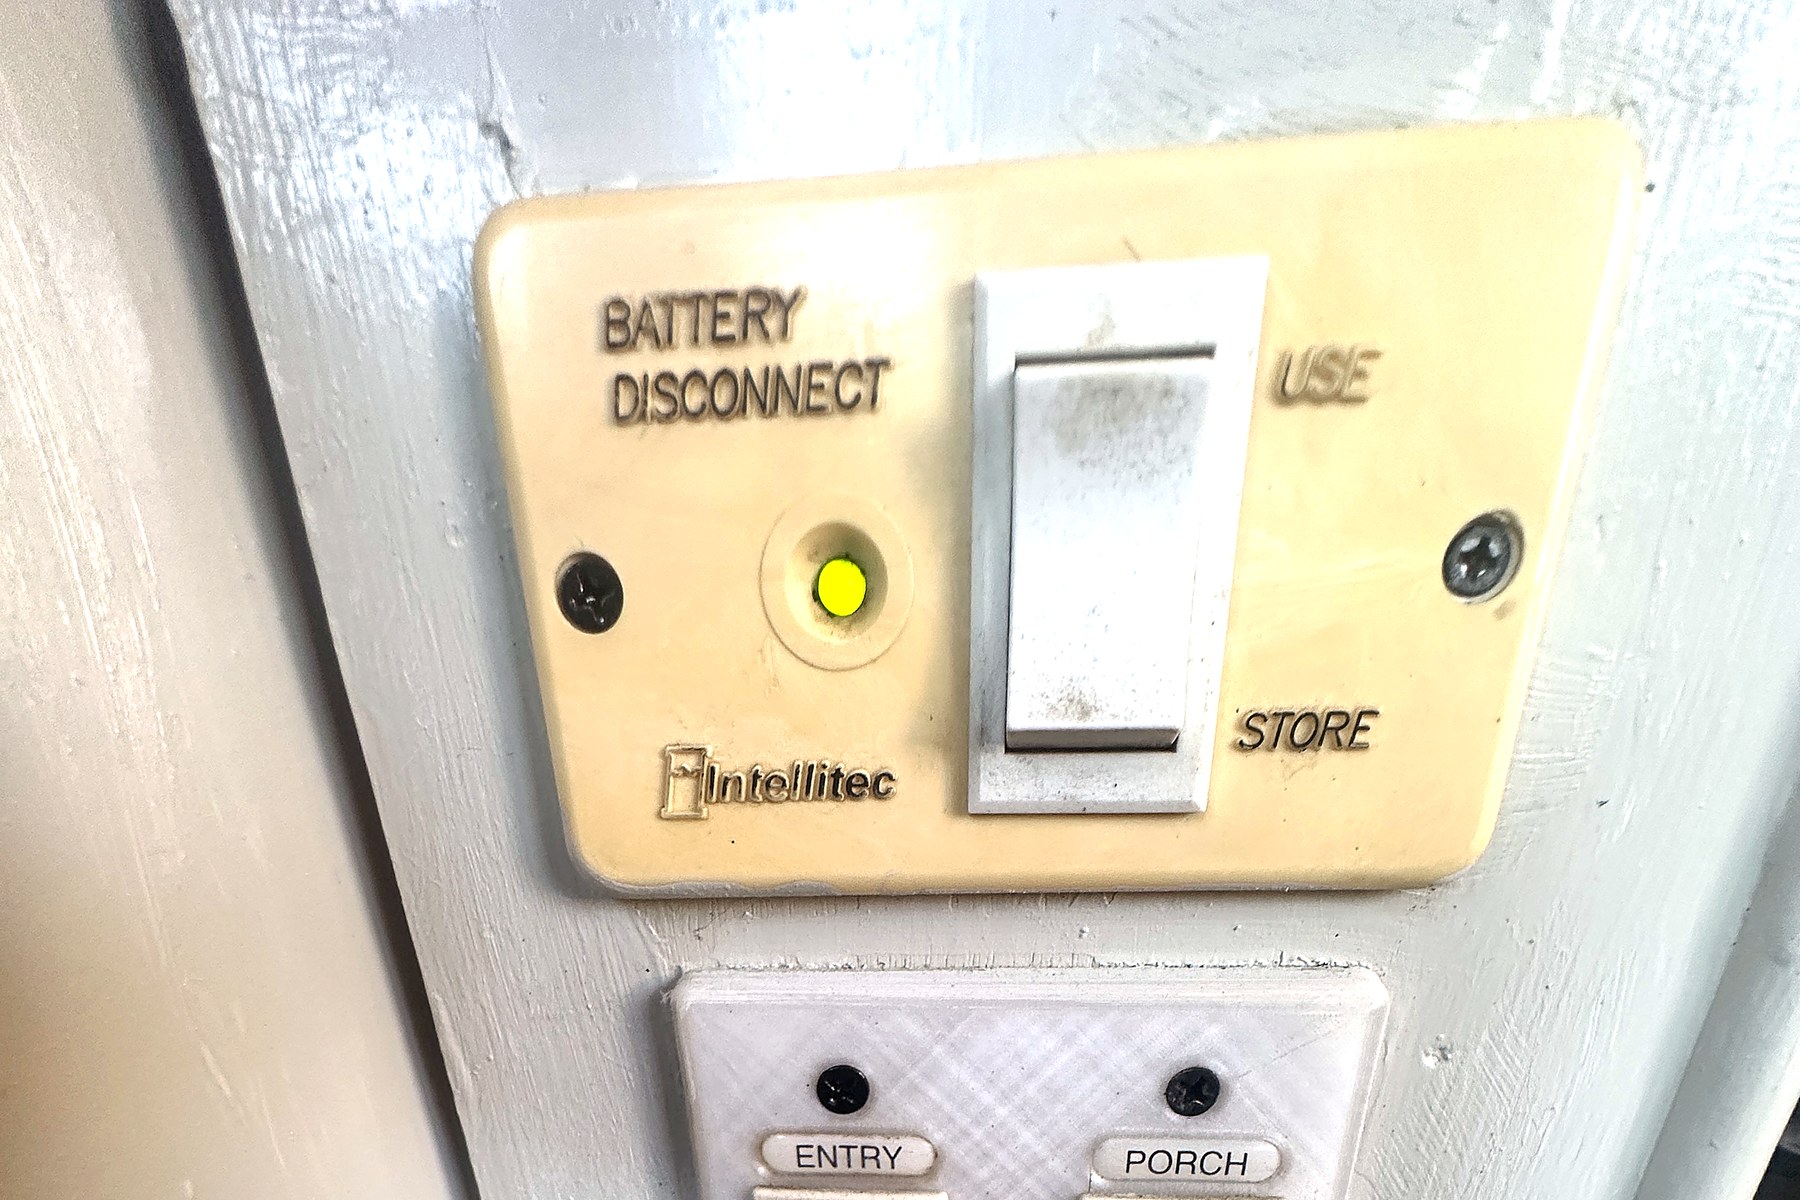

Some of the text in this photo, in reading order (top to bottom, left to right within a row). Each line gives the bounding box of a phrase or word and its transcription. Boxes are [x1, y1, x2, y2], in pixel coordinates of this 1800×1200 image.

[605, 285, 808, 350] BATTERY
[613, 357, 892, 425] DISCONNECT
[1272, 345, 1383, 405] USE
[1237, 709, 1380, 751] STORE
[706, 759, 897, 803] Intellitec
[796, 1144, 903, 1170] ENTRY
[1125, 1149, 1249, 1176] PORCH
